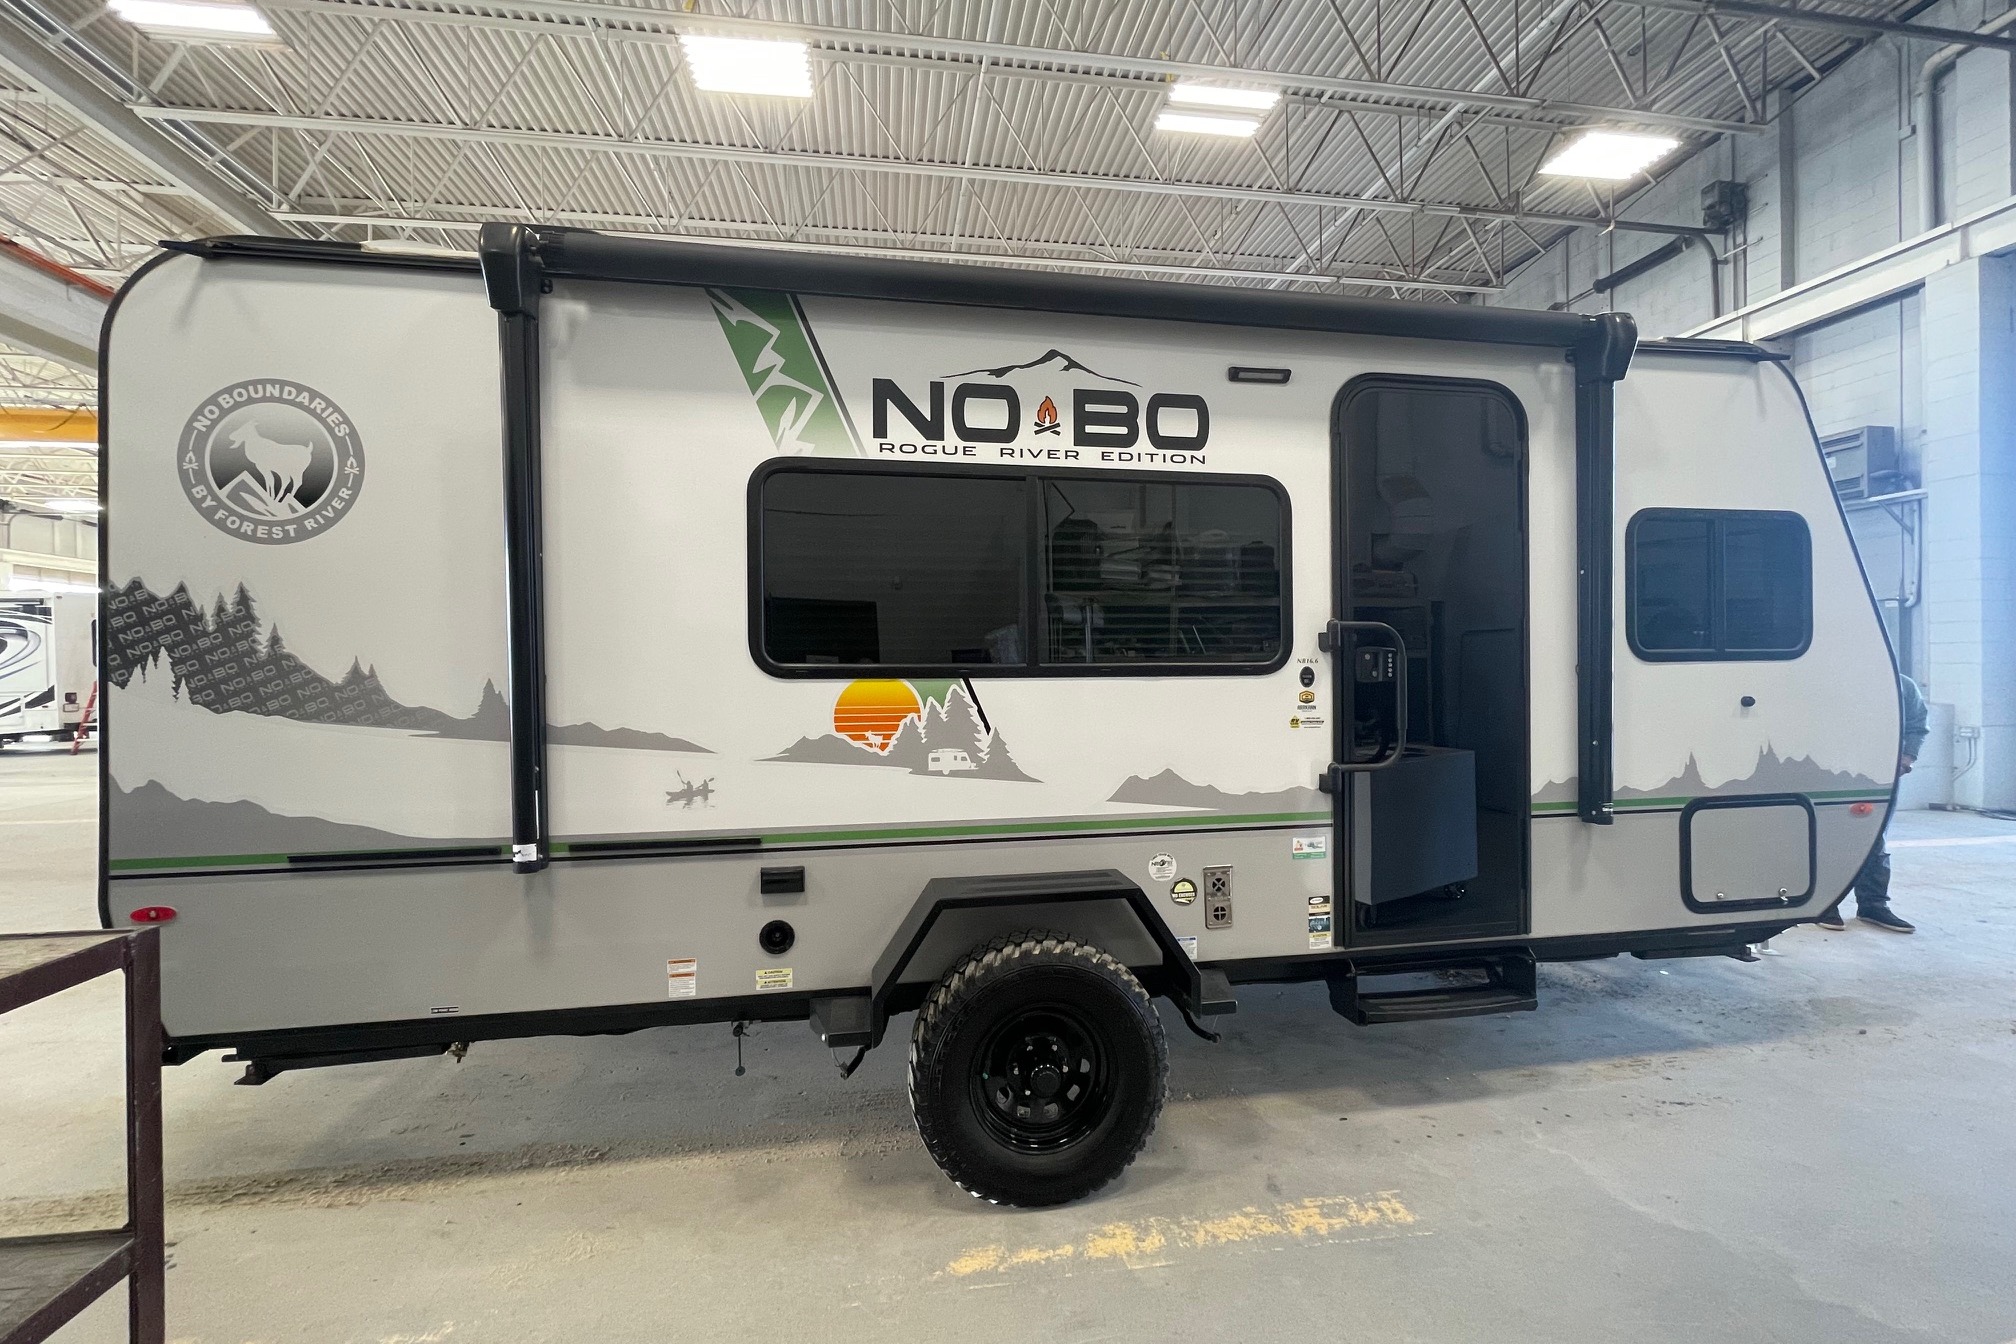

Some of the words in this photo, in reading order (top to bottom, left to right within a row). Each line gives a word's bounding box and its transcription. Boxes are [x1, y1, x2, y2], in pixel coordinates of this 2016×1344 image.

[192, 405, 220, 432] NO
[217, 383, 350, 437] BOUNDARIES
[879, 443, 977, 456] ROGUE
[1000, 448, 1080, 460] RIVER
[1101, 451, 1206, 465] EDITION
[191, 485, 217, 508] BY
[214, 509, 297, 539] FOREST
[304, 487, 352, 530] RIVER
